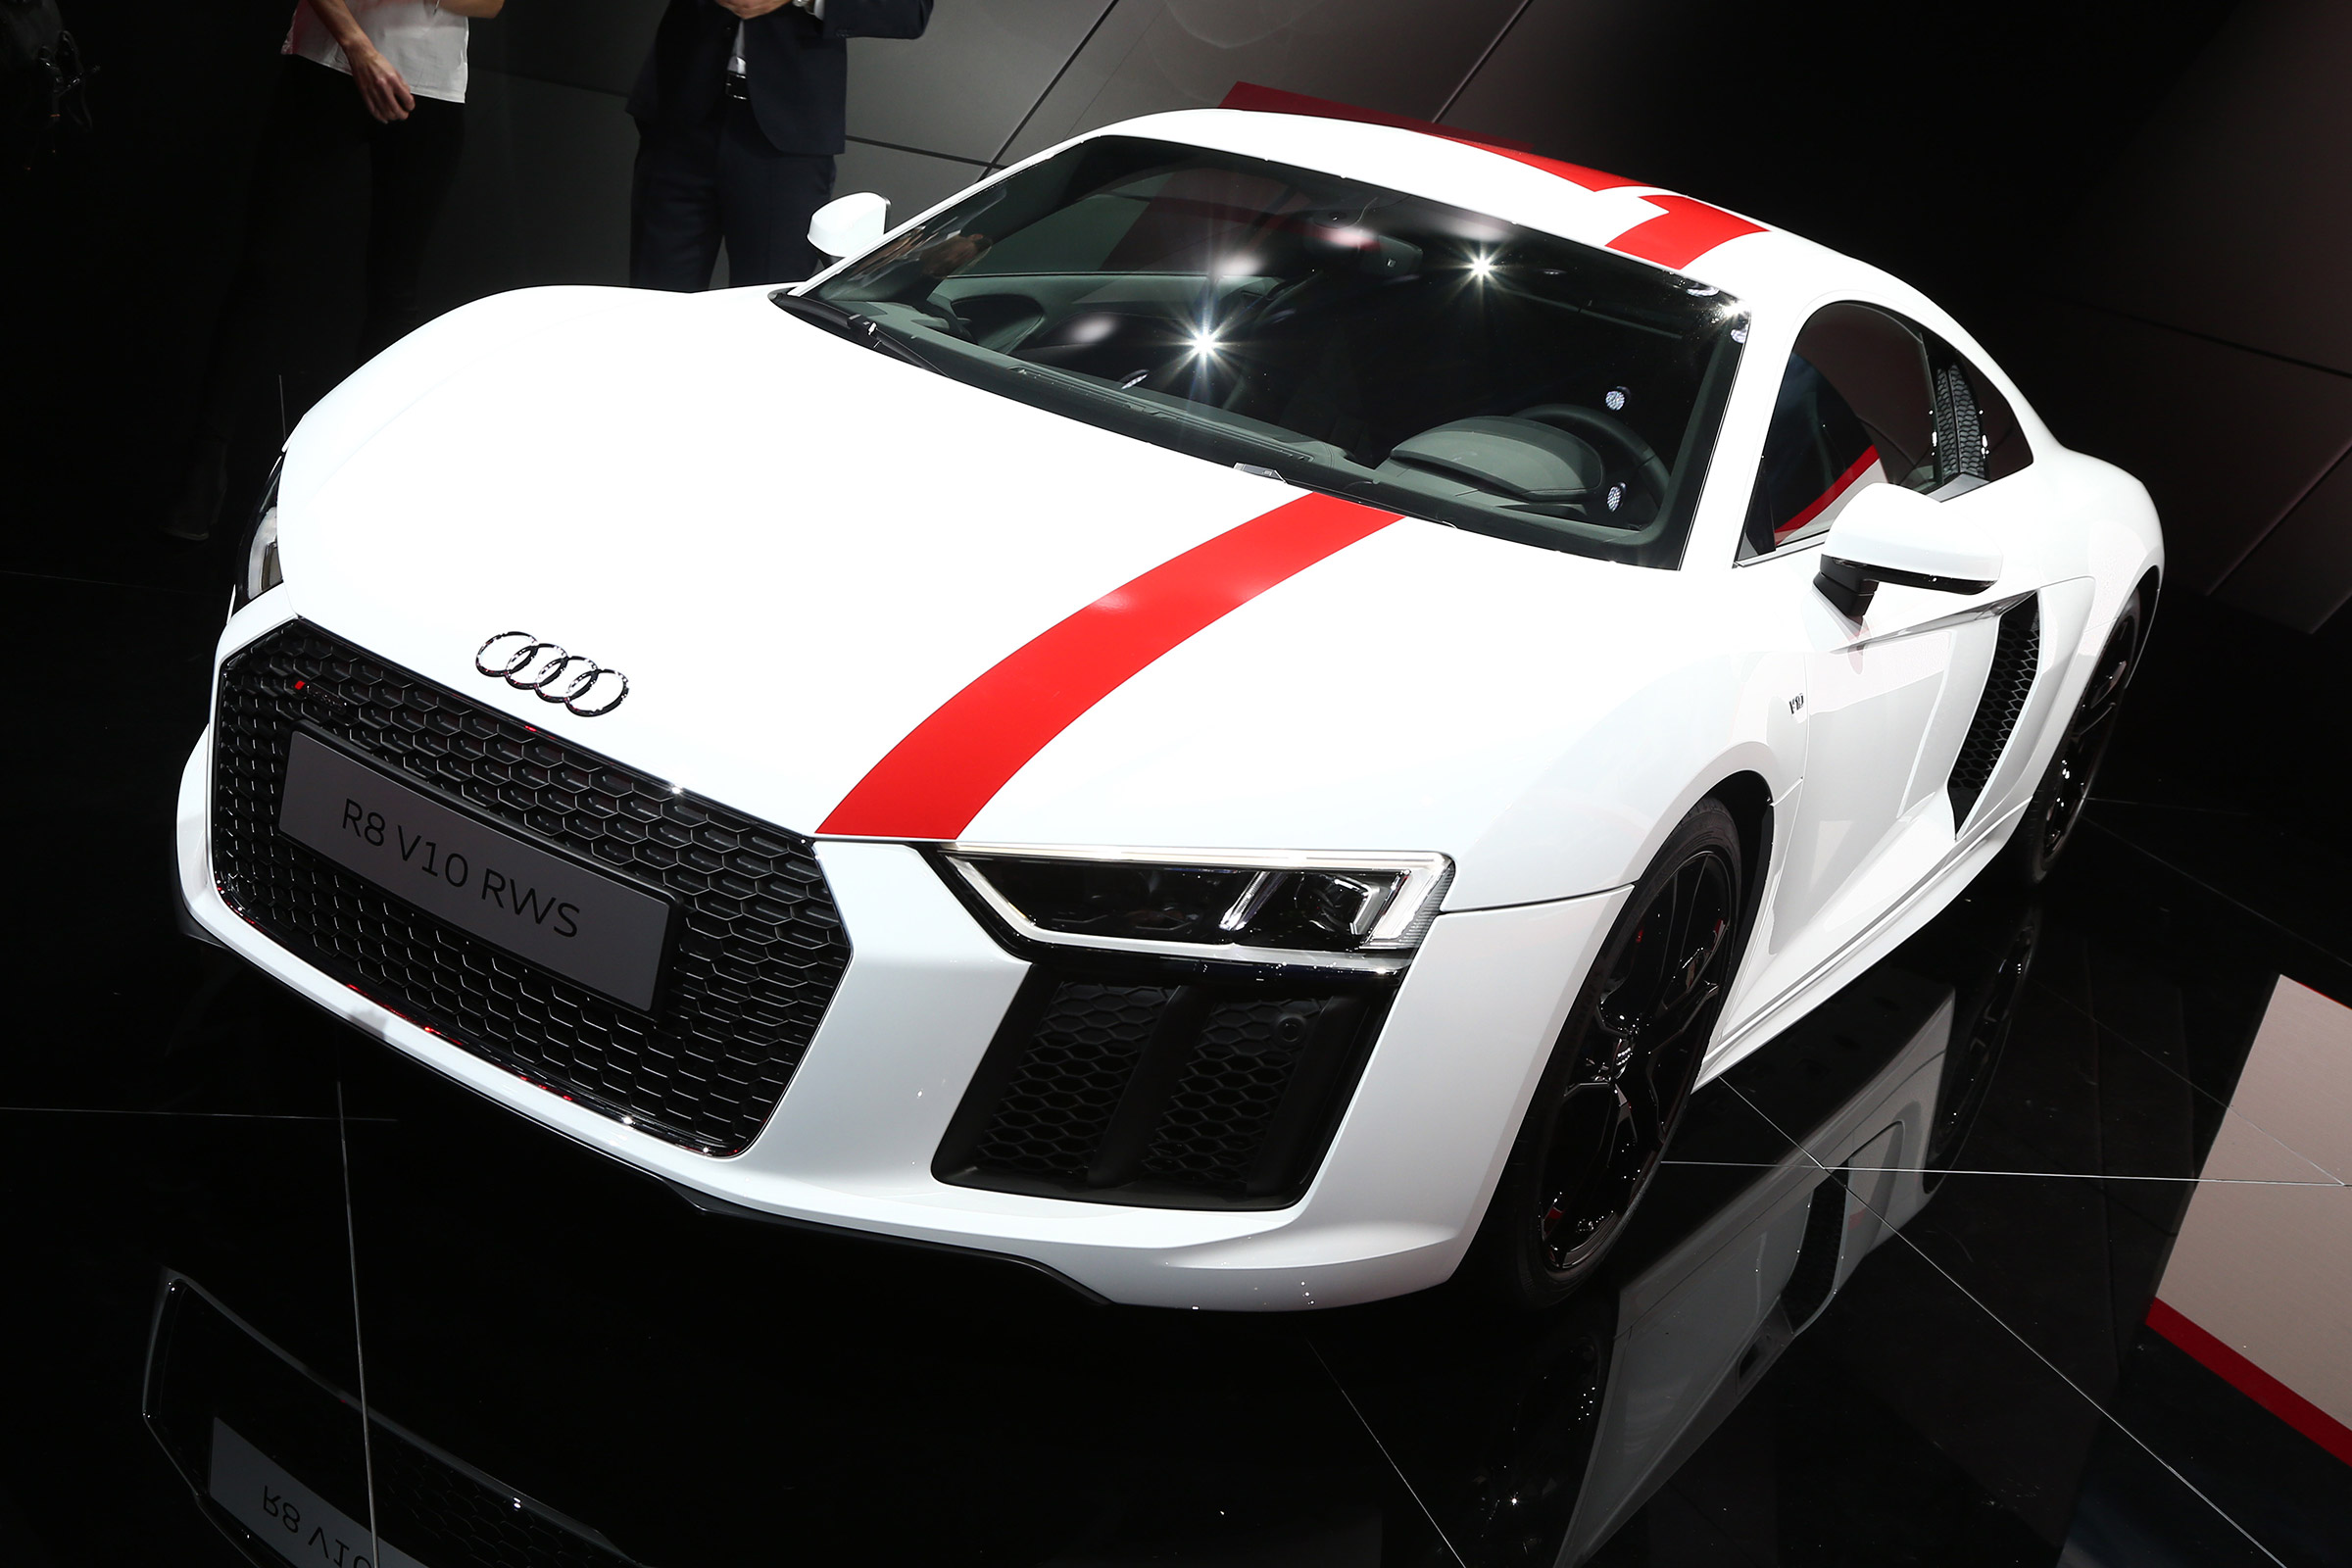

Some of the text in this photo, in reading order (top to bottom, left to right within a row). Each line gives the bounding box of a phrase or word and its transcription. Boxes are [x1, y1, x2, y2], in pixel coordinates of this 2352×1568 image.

[341, 798, 581, 938] R8 V10 RWS
